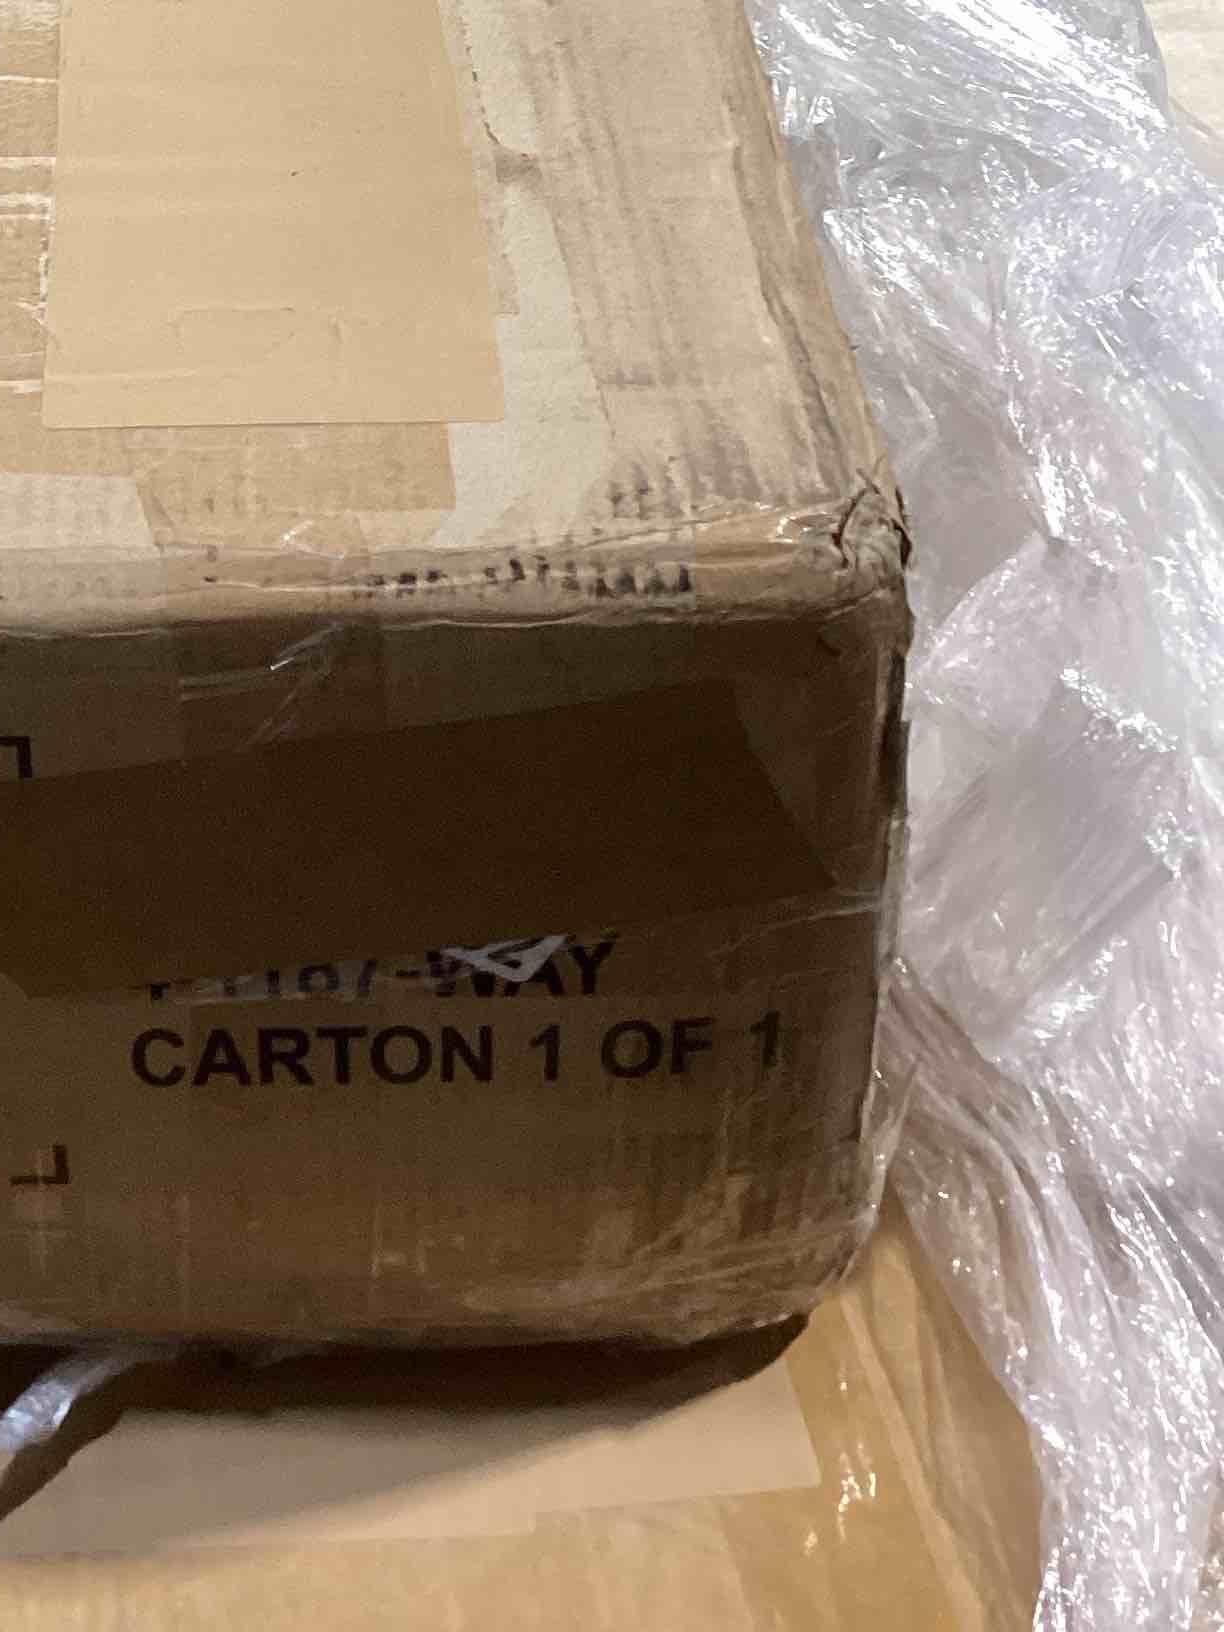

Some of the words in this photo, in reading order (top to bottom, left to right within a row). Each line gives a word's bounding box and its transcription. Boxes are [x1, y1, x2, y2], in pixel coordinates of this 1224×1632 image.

[130, 1024, 497, 1088] CARTON
[530, 1023, 562, 1083] 1
[599, 1015, 715, 1081] OF
[750, 1009, 782, 1071] 1
